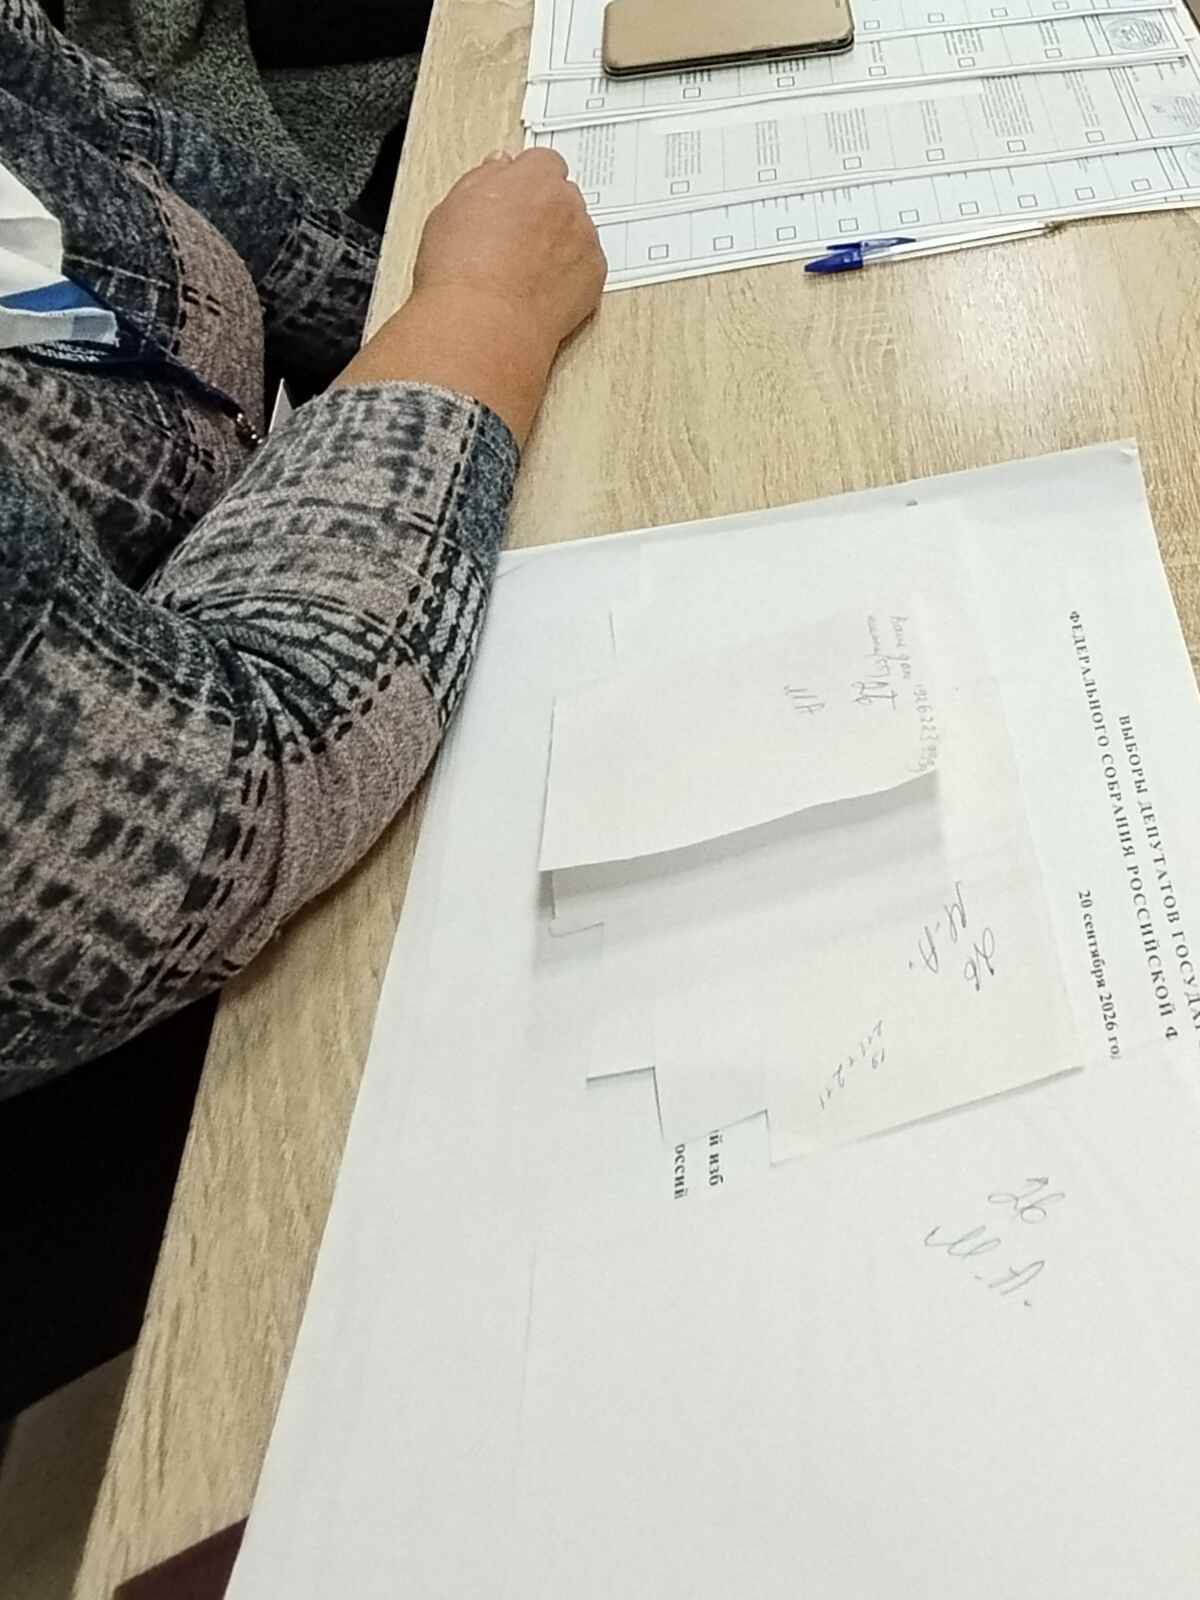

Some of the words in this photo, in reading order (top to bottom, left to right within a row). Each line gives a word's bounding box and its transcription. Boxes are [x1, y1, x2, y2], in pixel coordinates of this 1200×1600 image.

[1068, 610, 1110, 748] ФЕДЕРАЛЬНОГО
[1100, 753, 1136, 857] СОБРАНИЯ
[1126, 865, 1176, 1018] РОССИЙСКОЙ
[1118, 714, 1149, 795] ВЫБОРЫ
[1137, 800, 1181, 924] ДЕПУТАТОВ
[1078, 890, 1094, 910] 20
[1083, 913, 1107, 989] сентября
[1098, 992, 1120, 1032] 2026
